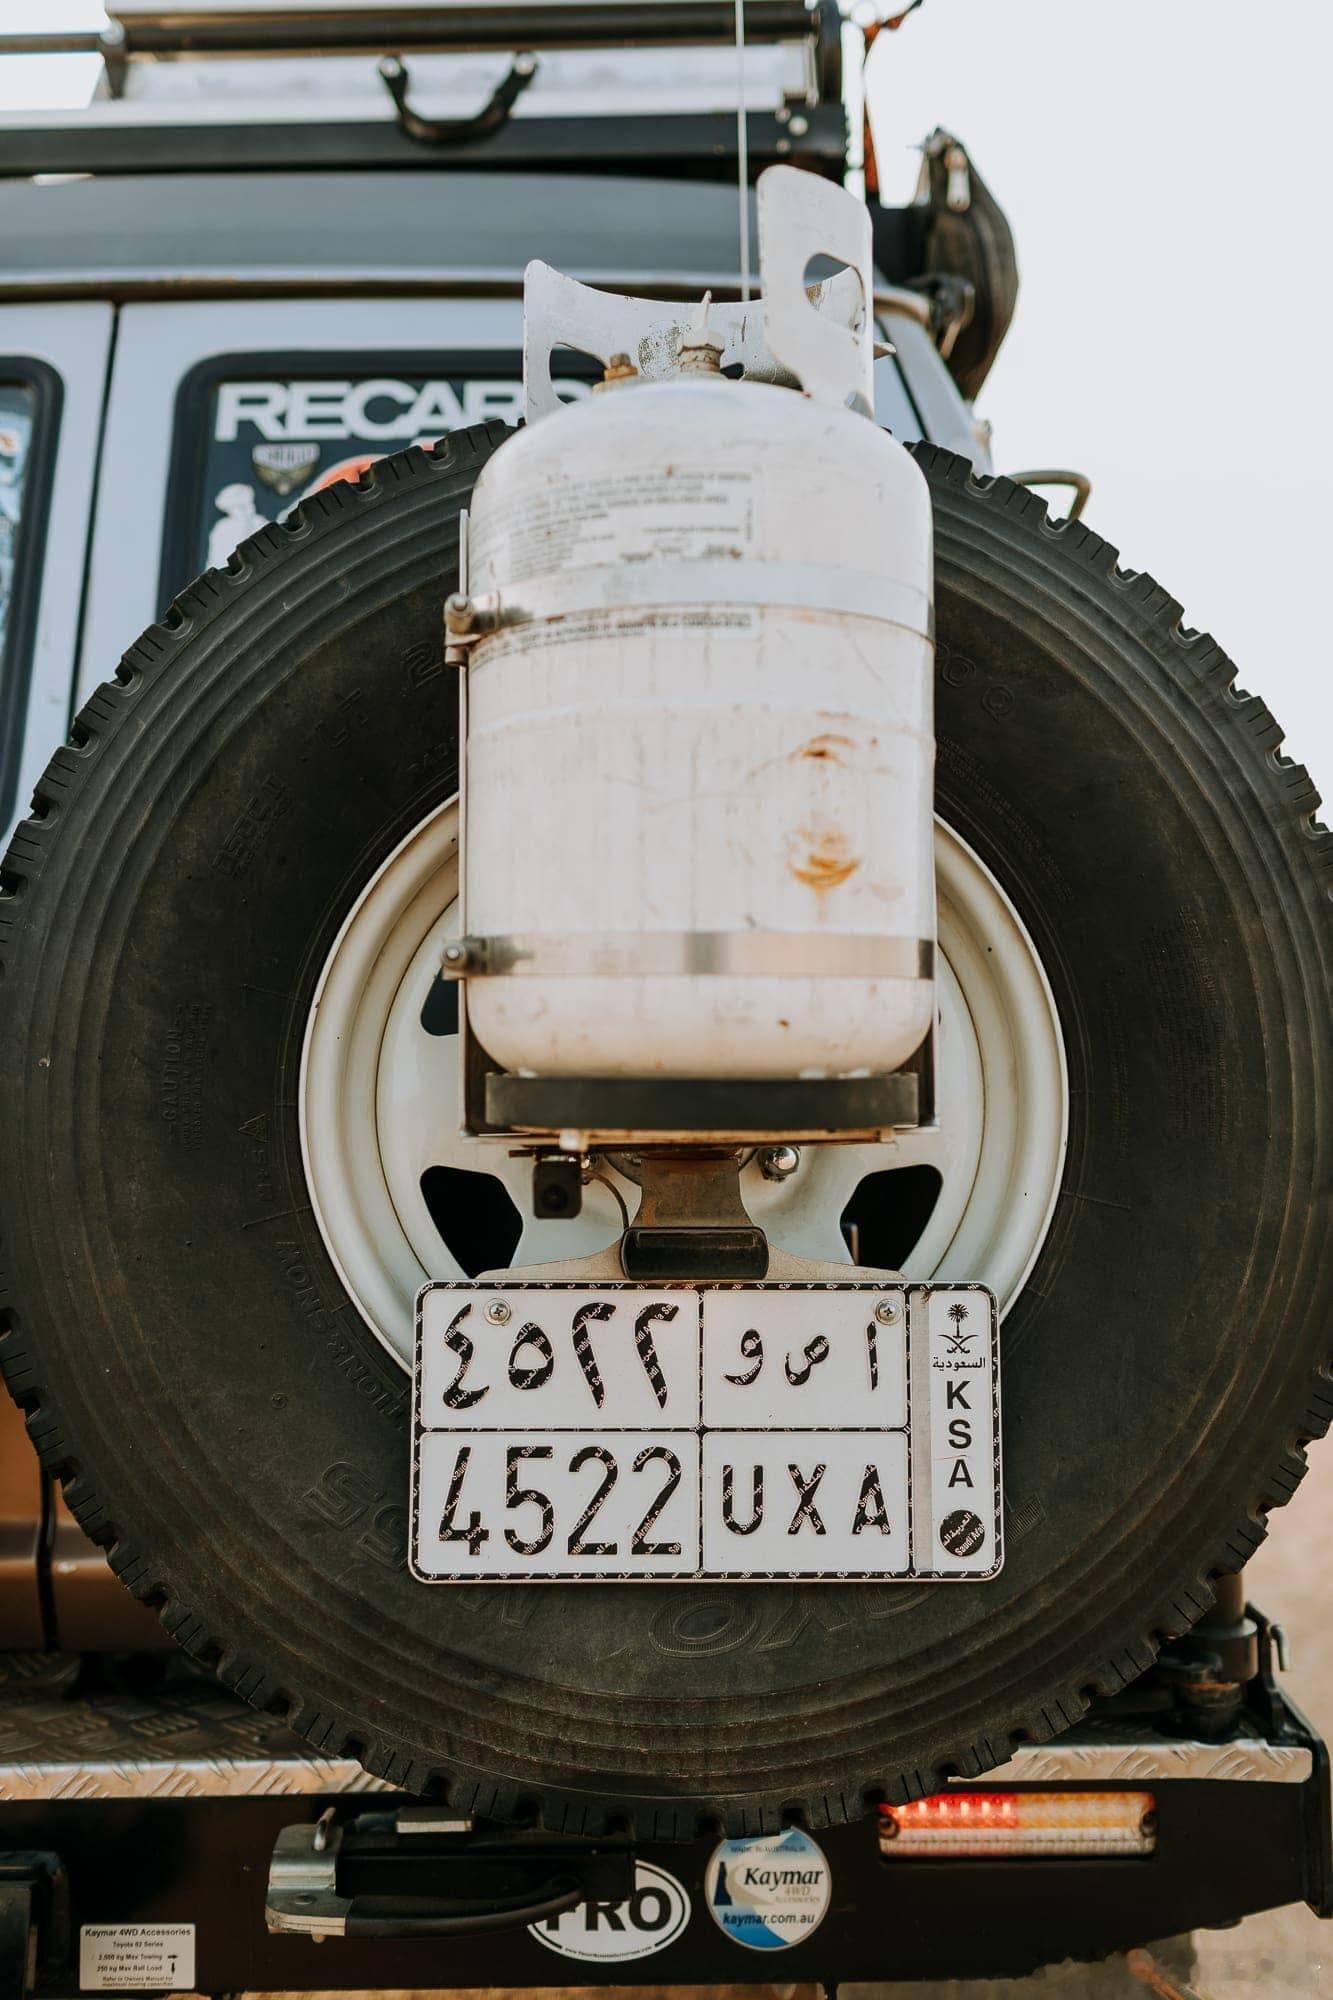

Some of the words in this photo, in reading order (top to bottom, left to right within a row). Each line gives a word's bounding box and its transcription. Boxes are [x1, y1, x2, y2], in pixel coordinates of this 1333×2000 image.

[932, 1356, 986, 1372] السعودية
[946, 1380, 975, 1489] KSA
[438, 1446, 682, 1556] 4522
[722, 1464, 892, 1536] UXA
[743, 1866, 824, 1892] Kaymar
[722, 1912, 816, 1928] kaymar.com.au
[85, 1927, 117, 1939] Kaymar
[119, 1927, 138, 1937] 4WD
[140, 1927, 191, 1937] Accessories
[112, 1941, 134, 1949] Toyota
